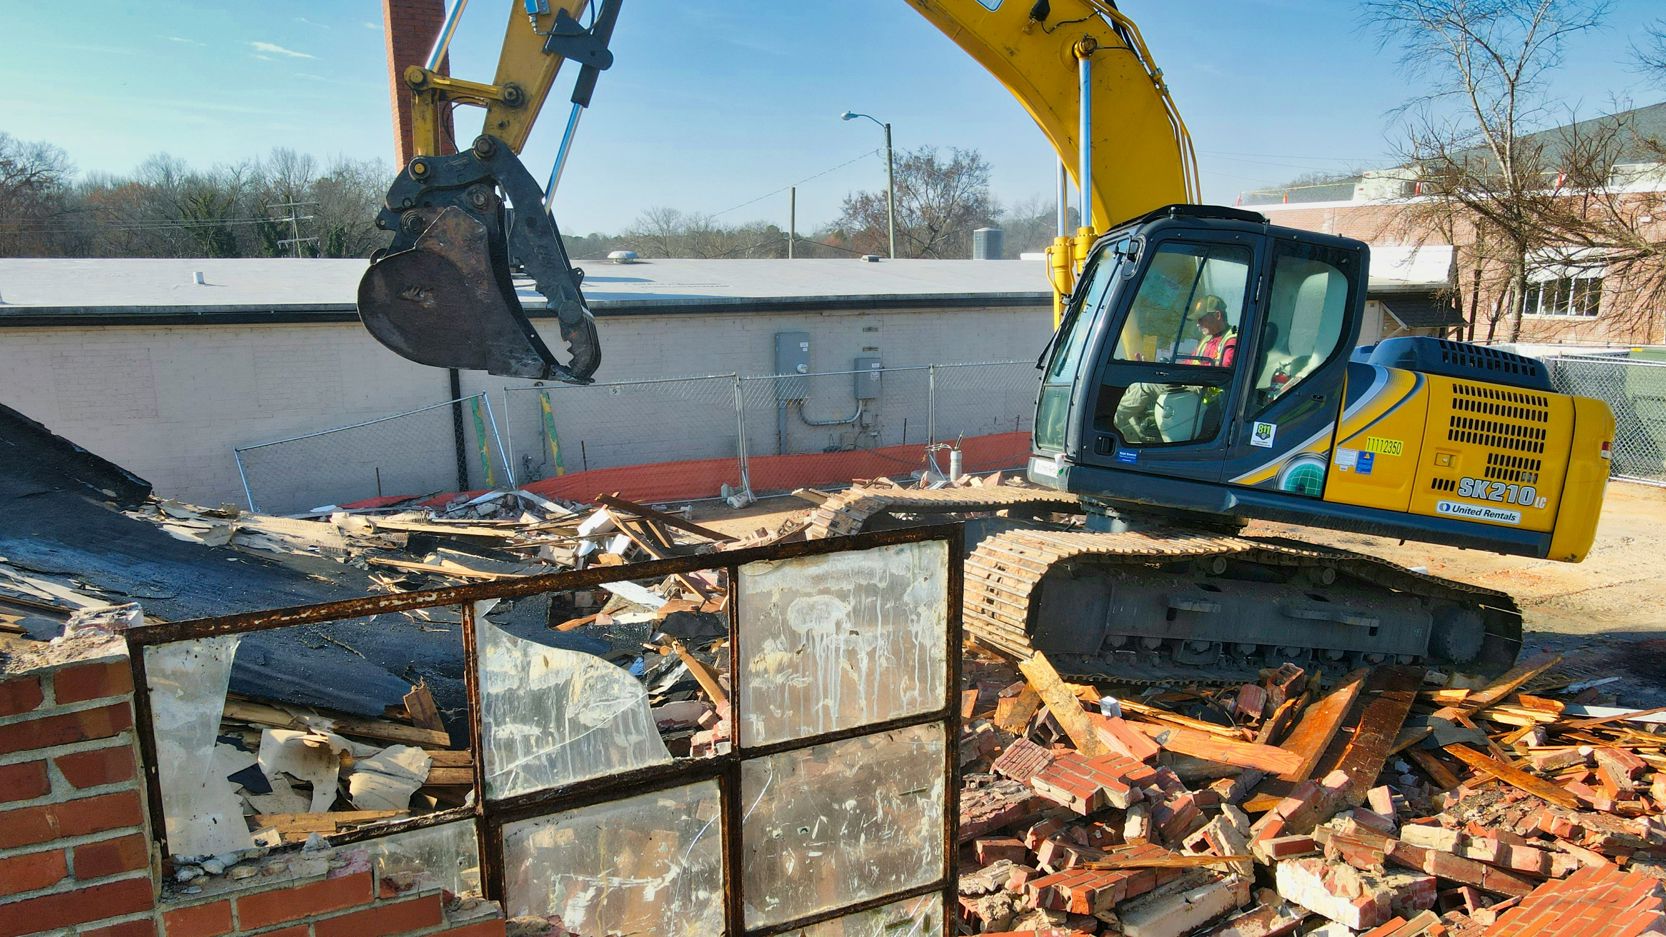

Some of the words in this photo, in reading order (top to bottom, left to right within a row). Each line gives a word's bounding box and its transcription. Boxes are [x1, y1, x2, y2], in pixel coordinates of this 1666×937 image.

[1258, 424, 1271, 435] 811
[1367, 438, 1402, 455] 11112350
[1457, 477, 1536, 506] SK210
[1452, 505, 1482, 517] United
[1483, 509, 1517, 522] Rentals
